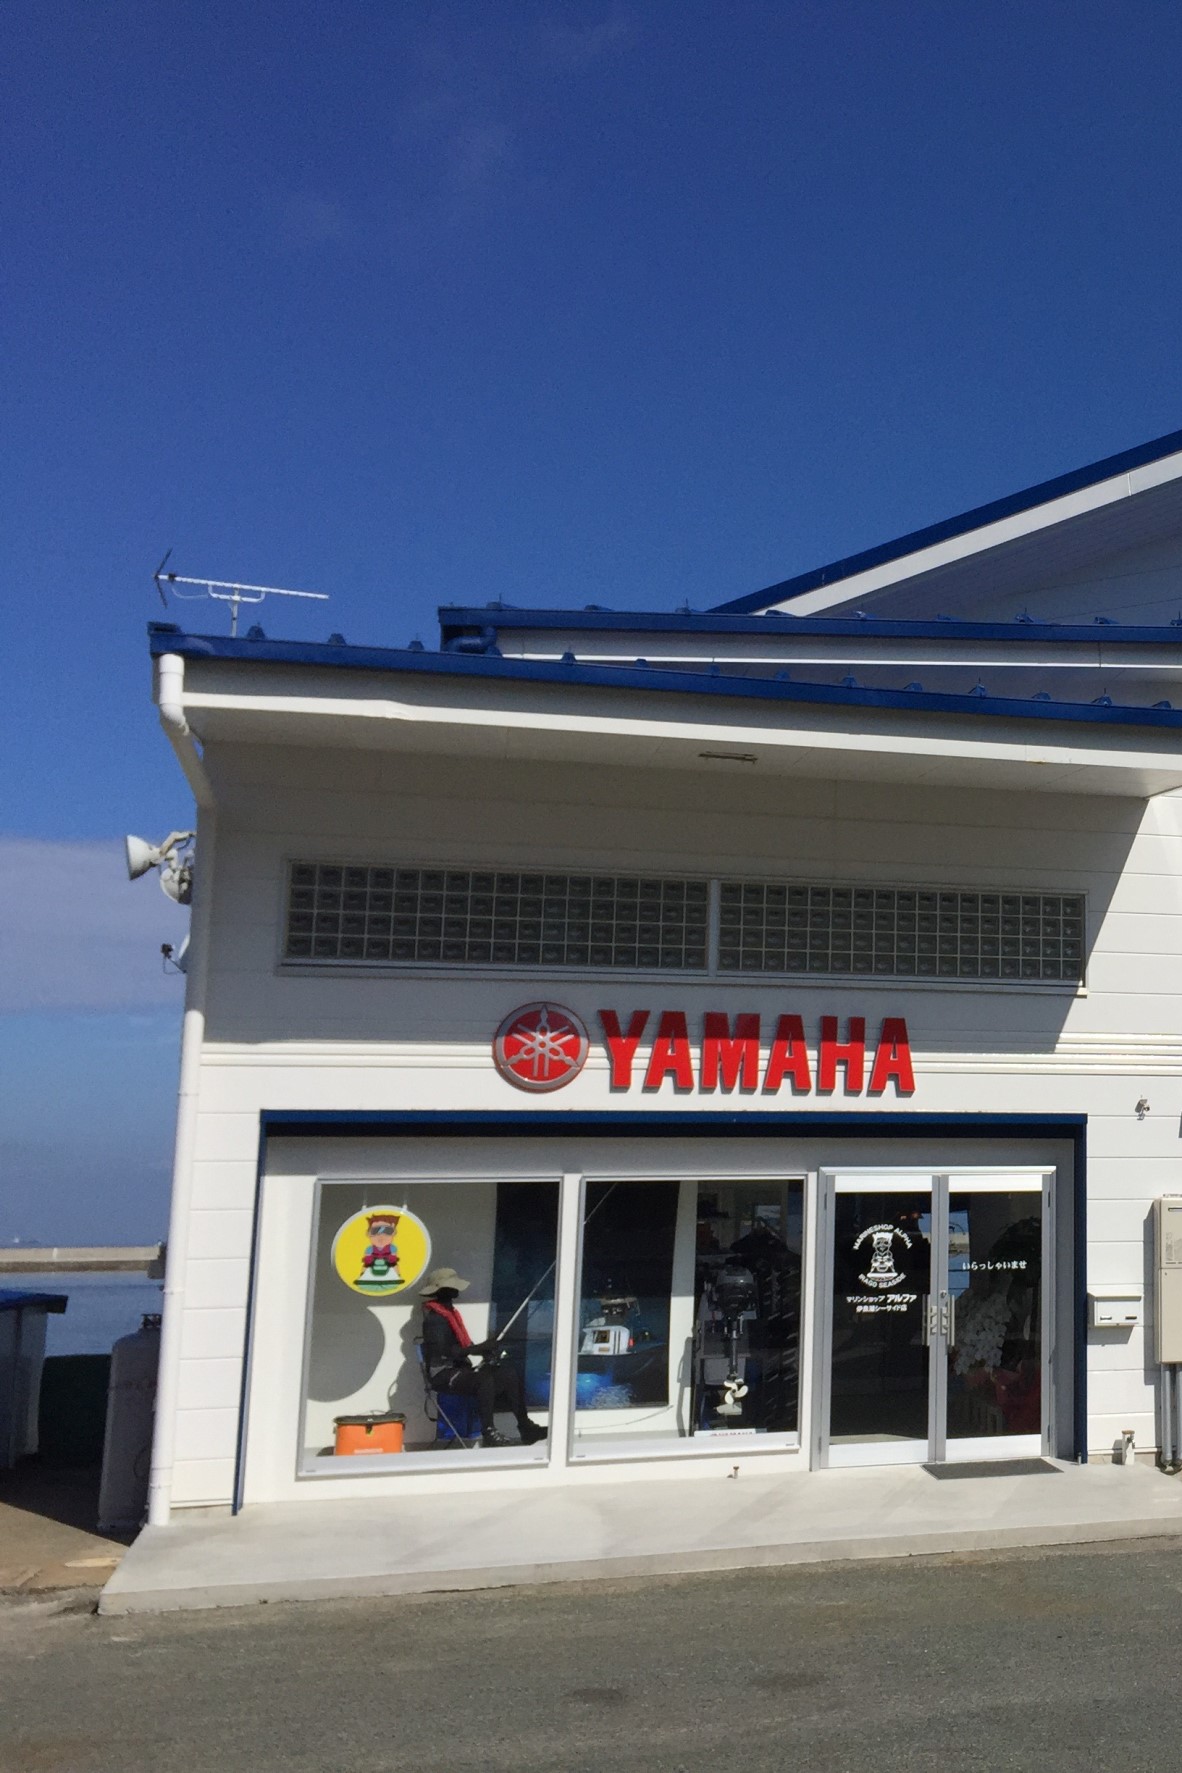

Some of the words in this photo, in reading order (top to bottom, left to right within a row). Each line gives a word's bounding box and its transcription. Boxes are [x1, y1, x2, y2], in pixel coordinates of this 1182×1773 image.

[598, 1009, 916, 1096] YAMAHA
[962, 1260, 1027, 1270] いらっしゃいませ
[846, 1295, 886, 1303] マリンショップ
[886, 1293, 917, 1303] アルファ
